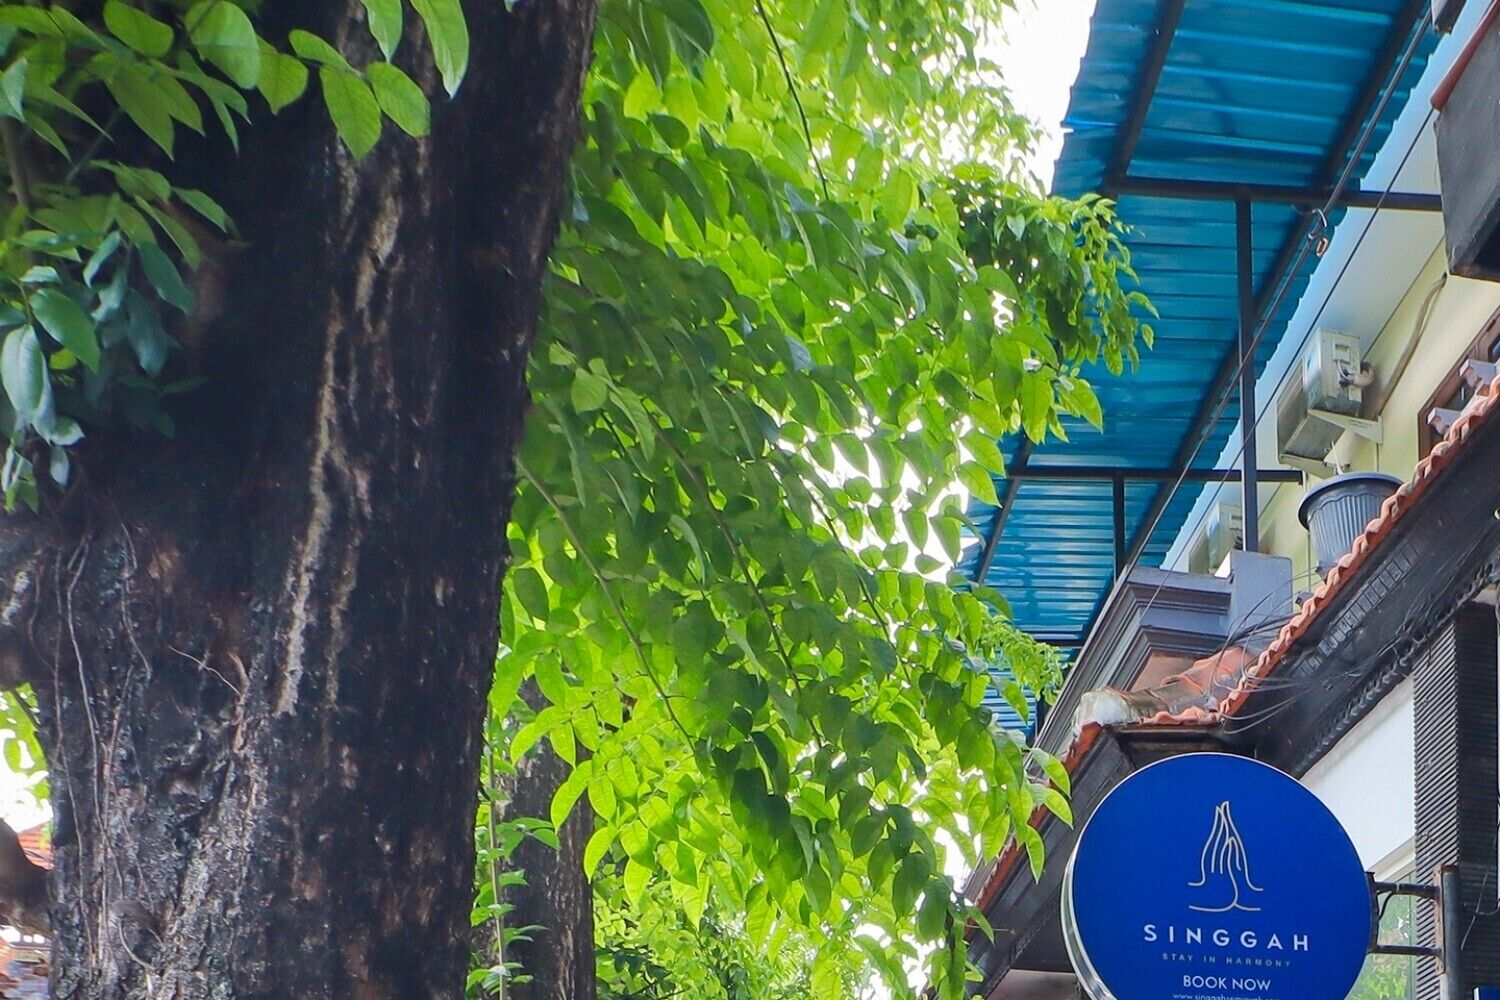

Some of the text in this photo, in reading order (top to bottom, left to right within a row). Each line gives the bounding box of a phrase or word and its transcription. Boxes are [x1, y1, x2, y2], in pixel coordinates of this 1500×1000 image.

[1143, 923, 1309, 951] SINGGAH
[1162, 952, 1291, 968] STAY IN HARMONY
[1183, 974, 1272, 992] BOOK NOW
